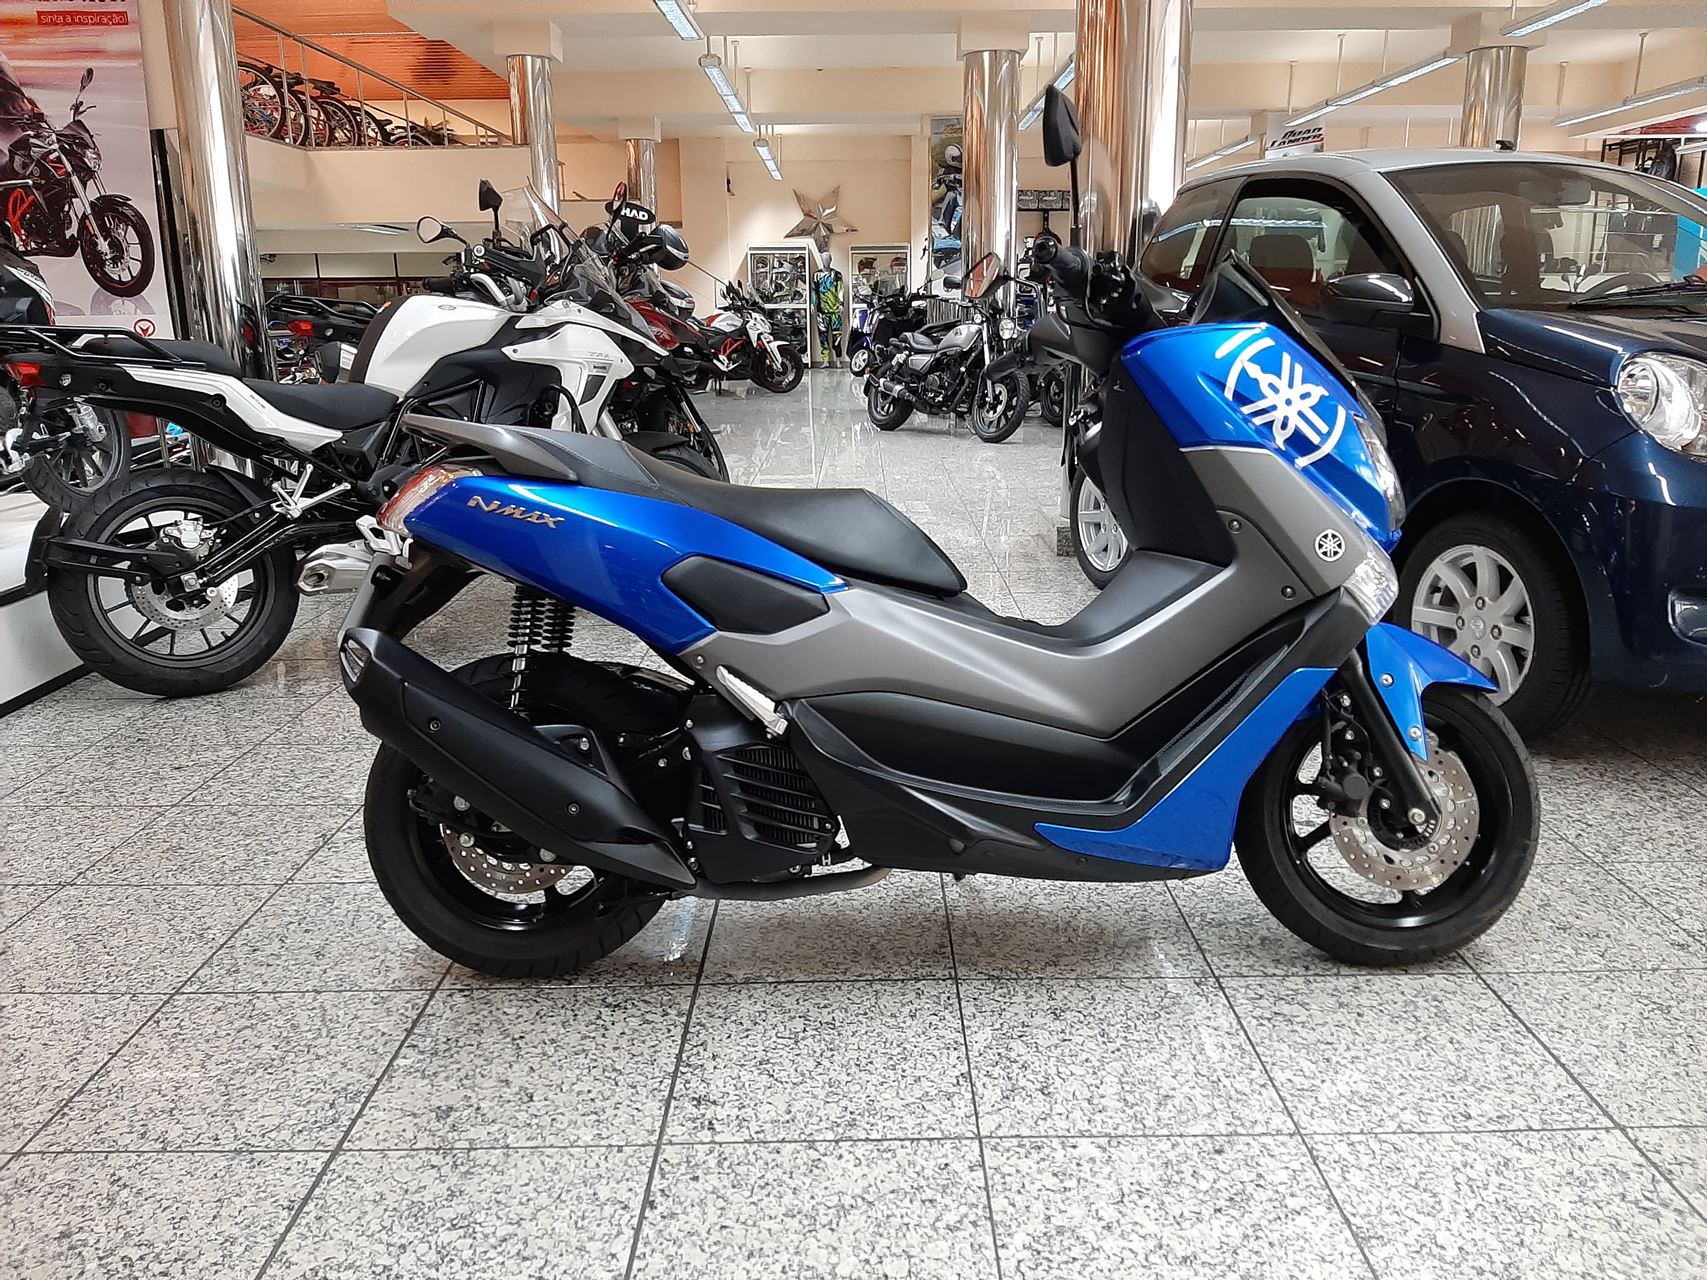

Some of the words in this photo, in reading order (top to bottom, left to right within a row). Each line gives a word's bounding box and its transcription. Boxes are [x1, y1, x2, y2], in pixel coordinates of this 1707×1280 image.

[40, 14, 63, 24] sinta
[65, 14, 72, 23] a
[73, 13, 128, 26] inspiração!
[620, 207, 649, 221] HAD
[467, 495, 565, 529] NMAX
